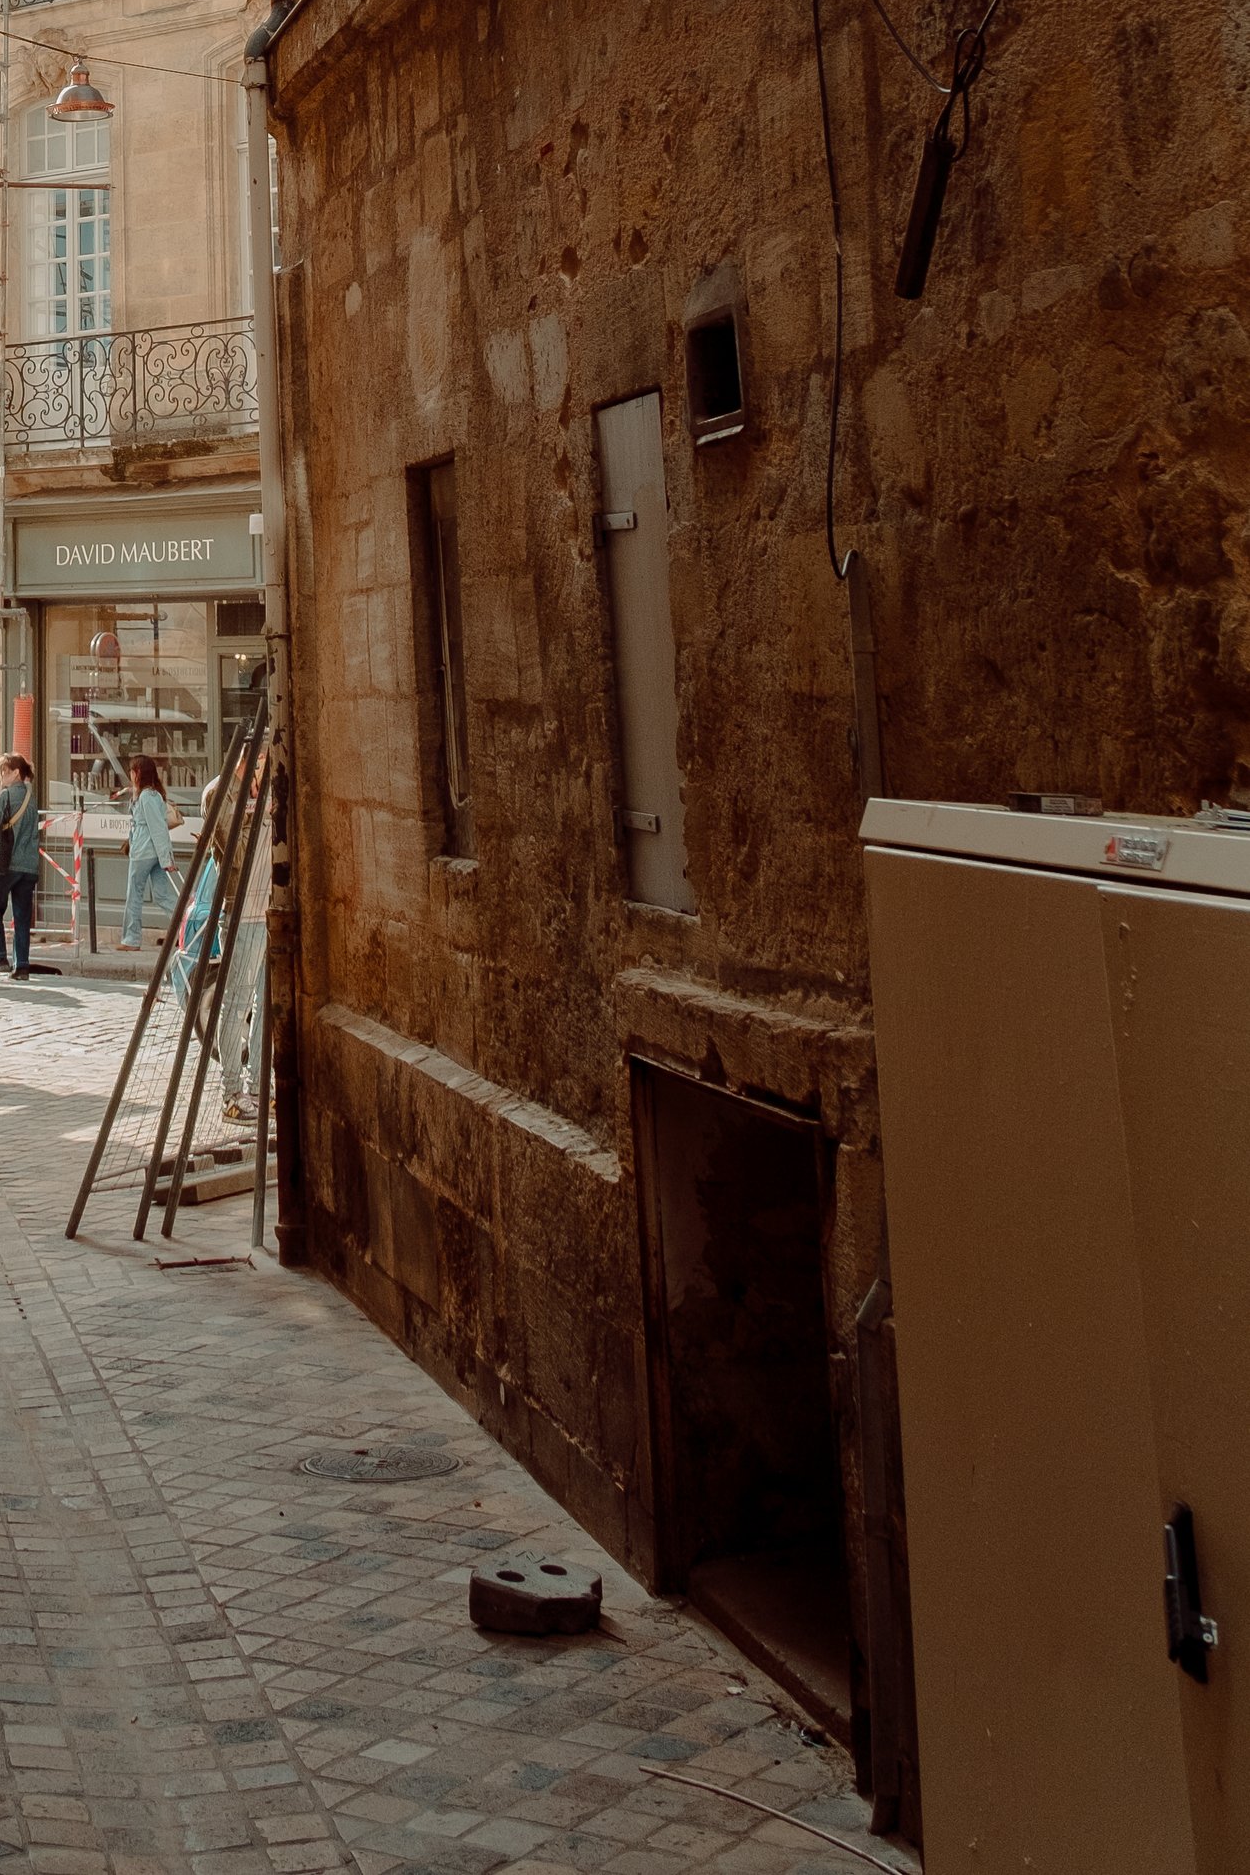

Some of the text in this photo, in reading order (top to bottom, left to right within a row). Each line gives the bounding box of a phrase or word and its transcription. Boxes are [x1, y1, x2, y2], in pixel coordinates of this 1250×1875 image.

[56, 539, 214, 566] DAVID MAUBERT
[100, 818, 108, 829] LA
